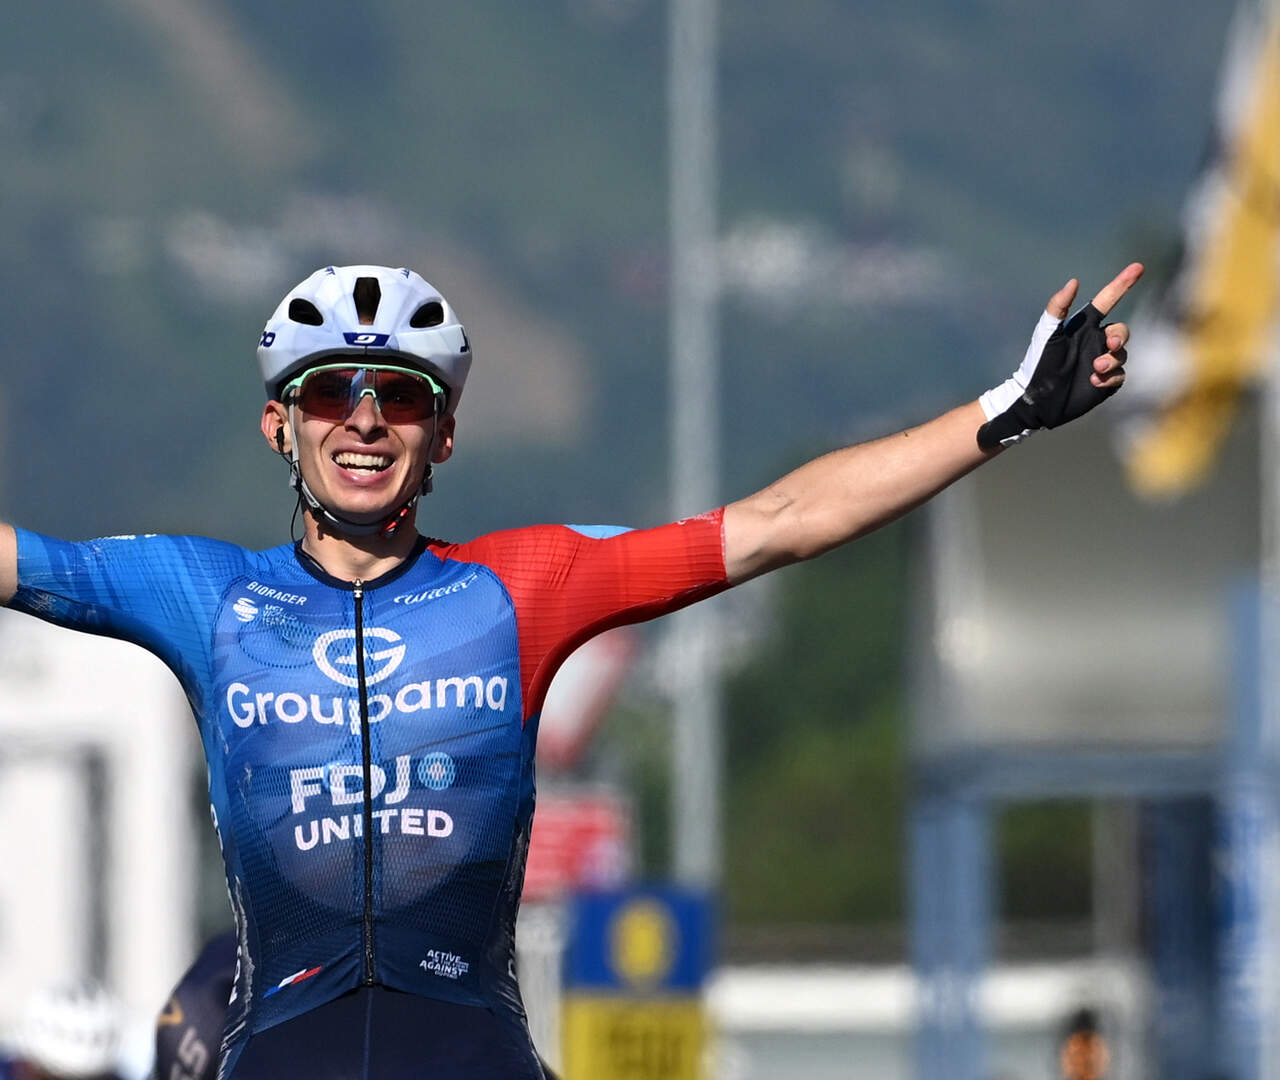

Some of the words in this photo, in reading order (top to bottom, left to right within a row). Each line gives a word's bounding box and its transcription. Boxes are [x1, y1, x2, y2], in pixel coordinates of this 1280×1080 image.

[246, 581, 308, 606] BIORACER
[226, 675, 508, 735] Groupama
[290, 755, 411, 815] FDJ
[294, 808, 454, 851] UNITED
[427, 949, 461, 964] ACTIVE
